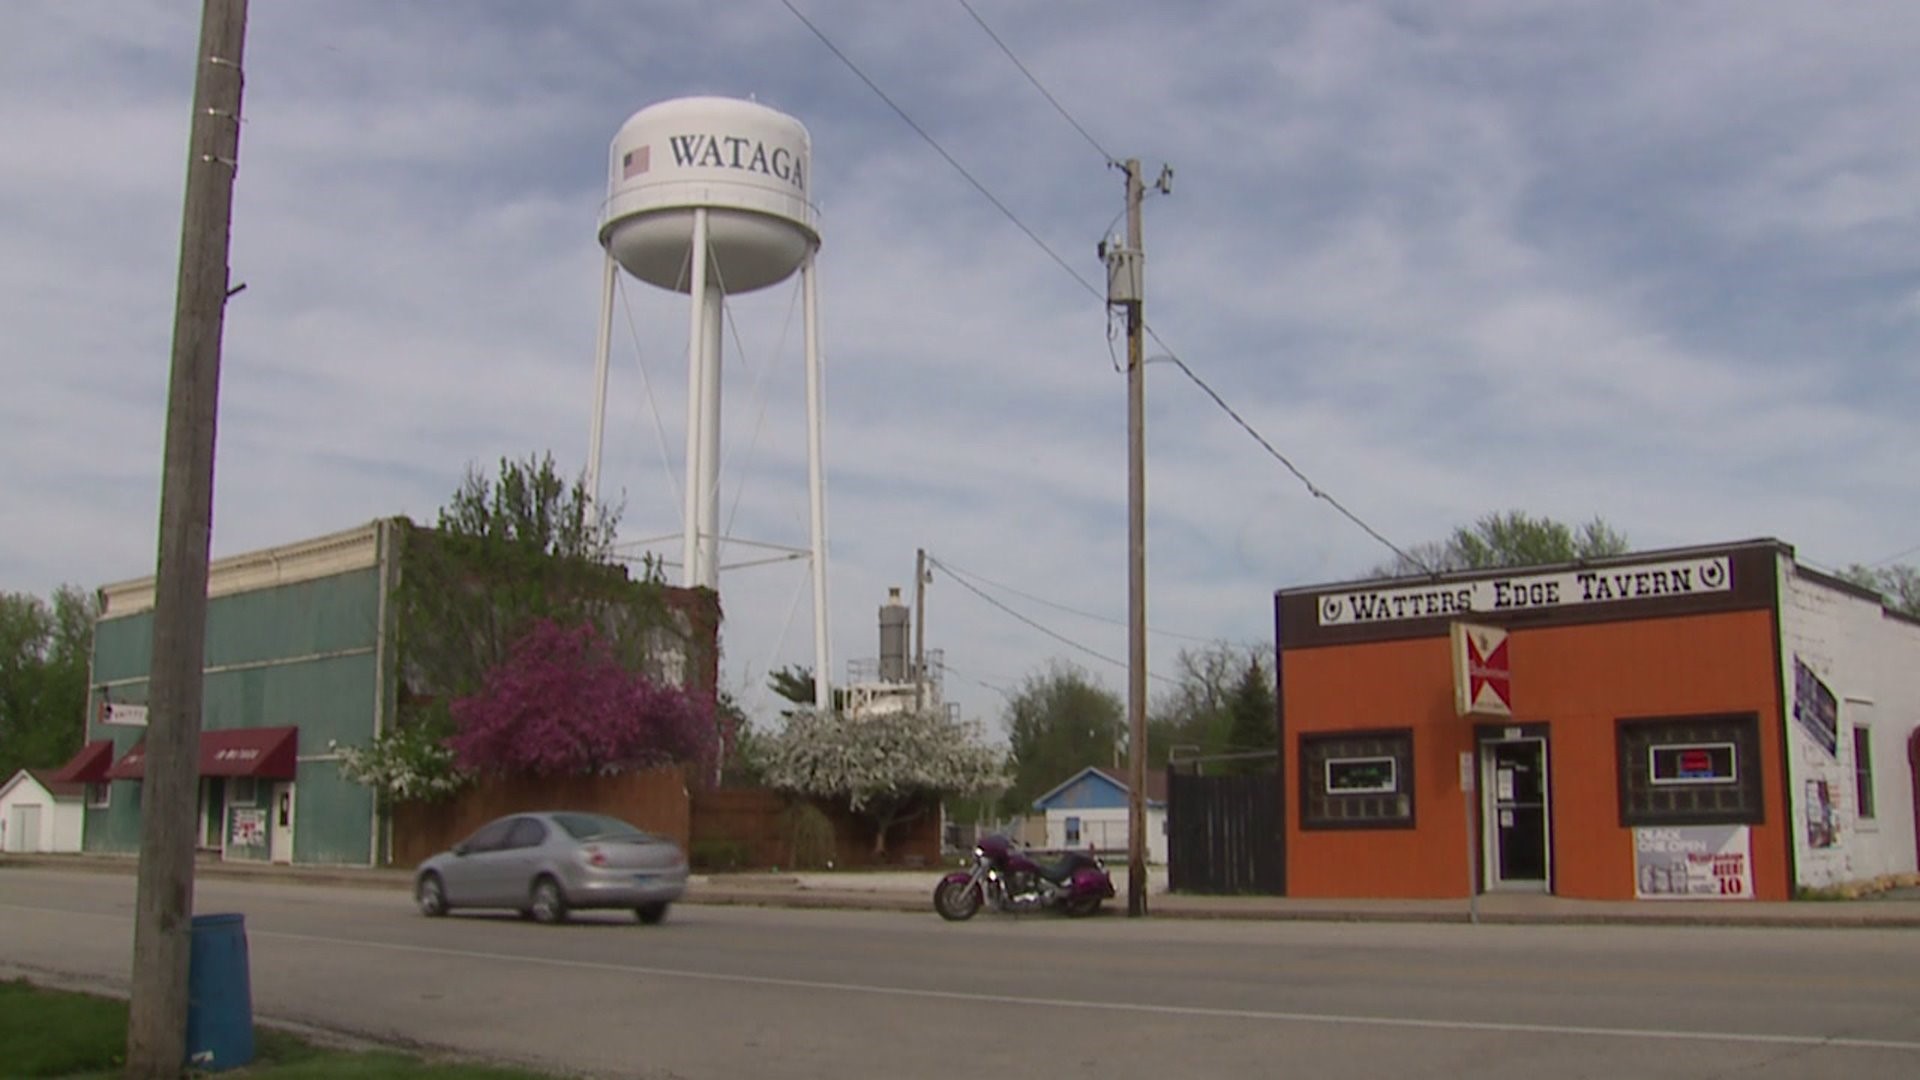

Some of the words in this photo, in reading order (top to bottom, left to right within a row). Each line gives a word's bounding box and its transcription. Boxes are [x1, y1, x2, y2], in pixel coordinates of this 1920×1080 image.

[669, 134, 804, 191] WATAGA
[1494, 581, 1560, 608] EDGE
[1577, 568, 1691, 600] TAVERN
[1720, 878, 1742, 895] 10
